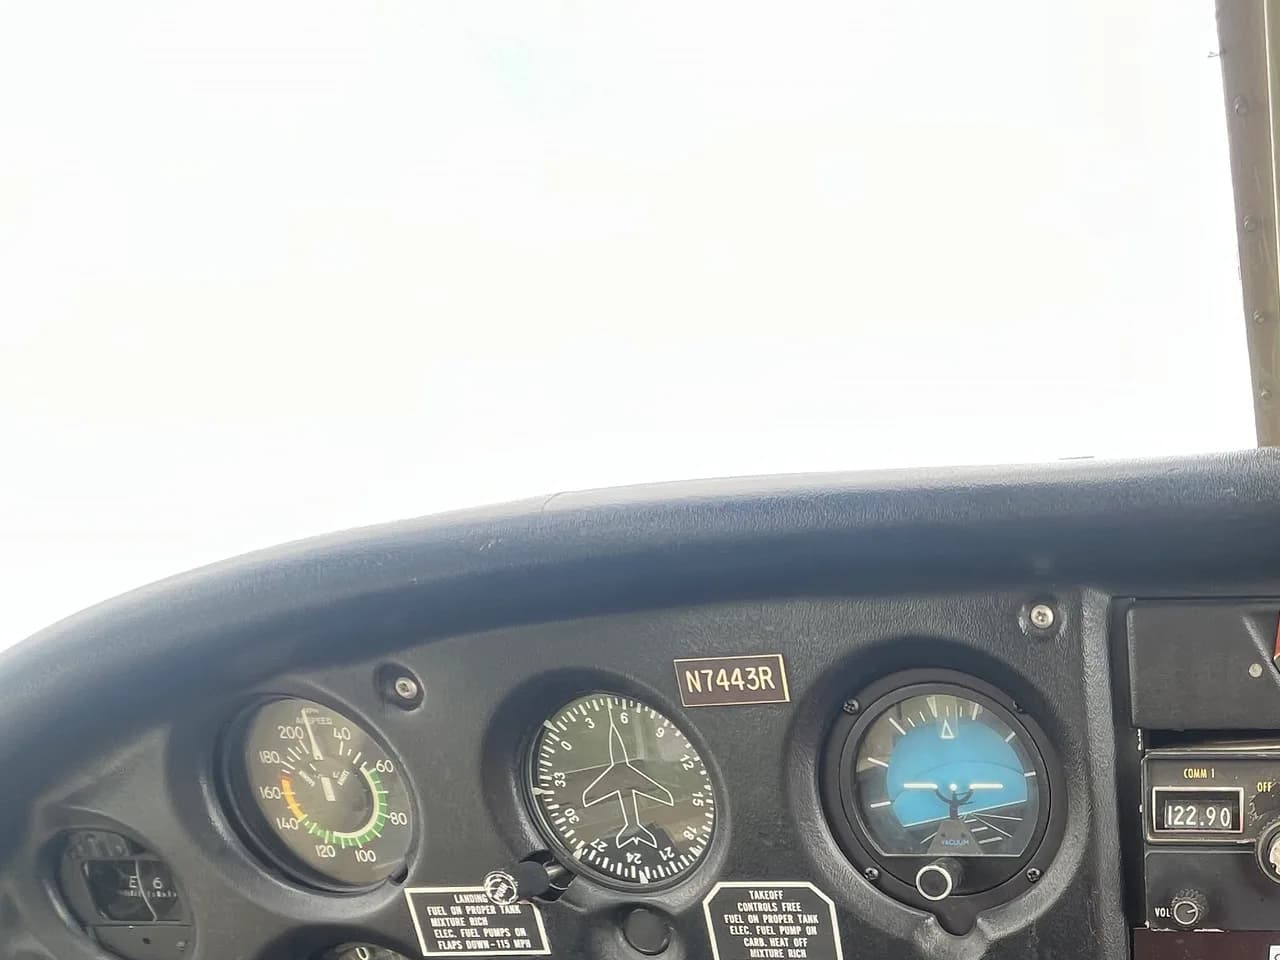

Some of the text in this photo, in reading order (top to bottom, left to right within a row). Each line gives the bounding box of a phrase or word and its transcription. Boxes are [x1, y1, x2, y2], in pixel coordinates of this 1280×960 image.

[685, 666, 775, 693] N7443R
[278, 726, 304, 740] 200
[334, 727, 352, 740] 40
[375, 760, 394, 773] 60
[1183, 768, 1208, 778] COMM
[1257, 782, 1272, 792] OFF
[259, 786, 281, 800] 160
[390, 812, 407, 825] 80
[1166, 806, 1230, 827] 122.90
[454, 894, 488, 903] LANDING
[749, 890, 783, 900] TAKEOFF
[427, 905, 521, 915] FUEL ON PROPER TANK
[738, 902, 802, 912] CONTROLS FREE
[1155, 908, 1170, 918] VOL
[430, 917, 488, 927] MIXTURE RICH
[724, 914, 819, 924] FUEL ON PROPER TANK
[434, 928, 526, 938] ELEC. FUEL PUMPS ON
[730, 926, 817, 935] ELEC. FUEL PUMP ON
[437, 941, 462, 949] FLAPS
[513, 939, 531, 948] MPH
[744, 938, 807, 946] CARB. HEAT OFF
[750, 949, 806, 958] MIXTURE RICH
